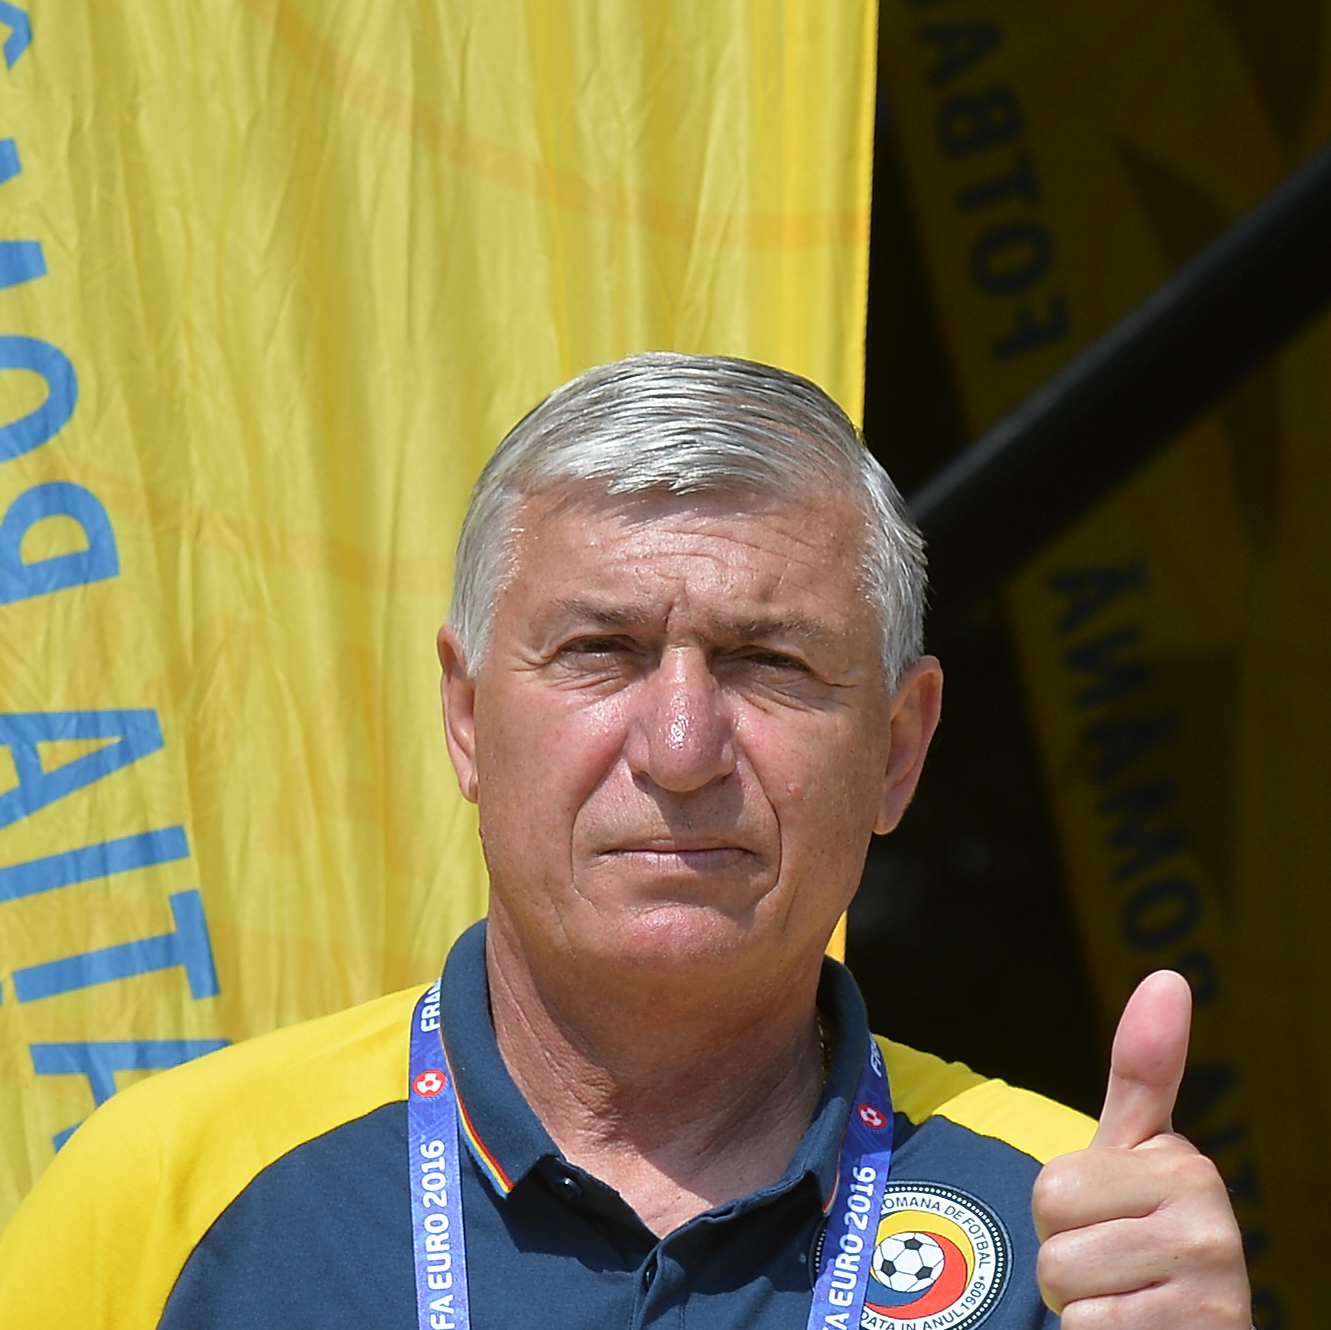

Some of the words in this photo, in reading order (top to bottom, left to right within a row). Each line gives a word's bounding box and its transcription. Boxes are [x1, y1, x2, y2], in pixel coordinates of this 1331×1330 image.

[420, 1139, 448, 1208] 2016
[844, 1166, 877, 1231] 2016
[424, 1213, 453, 1290] EURO
[883, 1196, 941, 1212] OMANA
[944, 1205, 965, 1221] DE
[962, 1217, 991, 1269] FOTBAL
[829, 1233, 864, 1307] EURO
[960, 1281, 987, 1311] 1909
